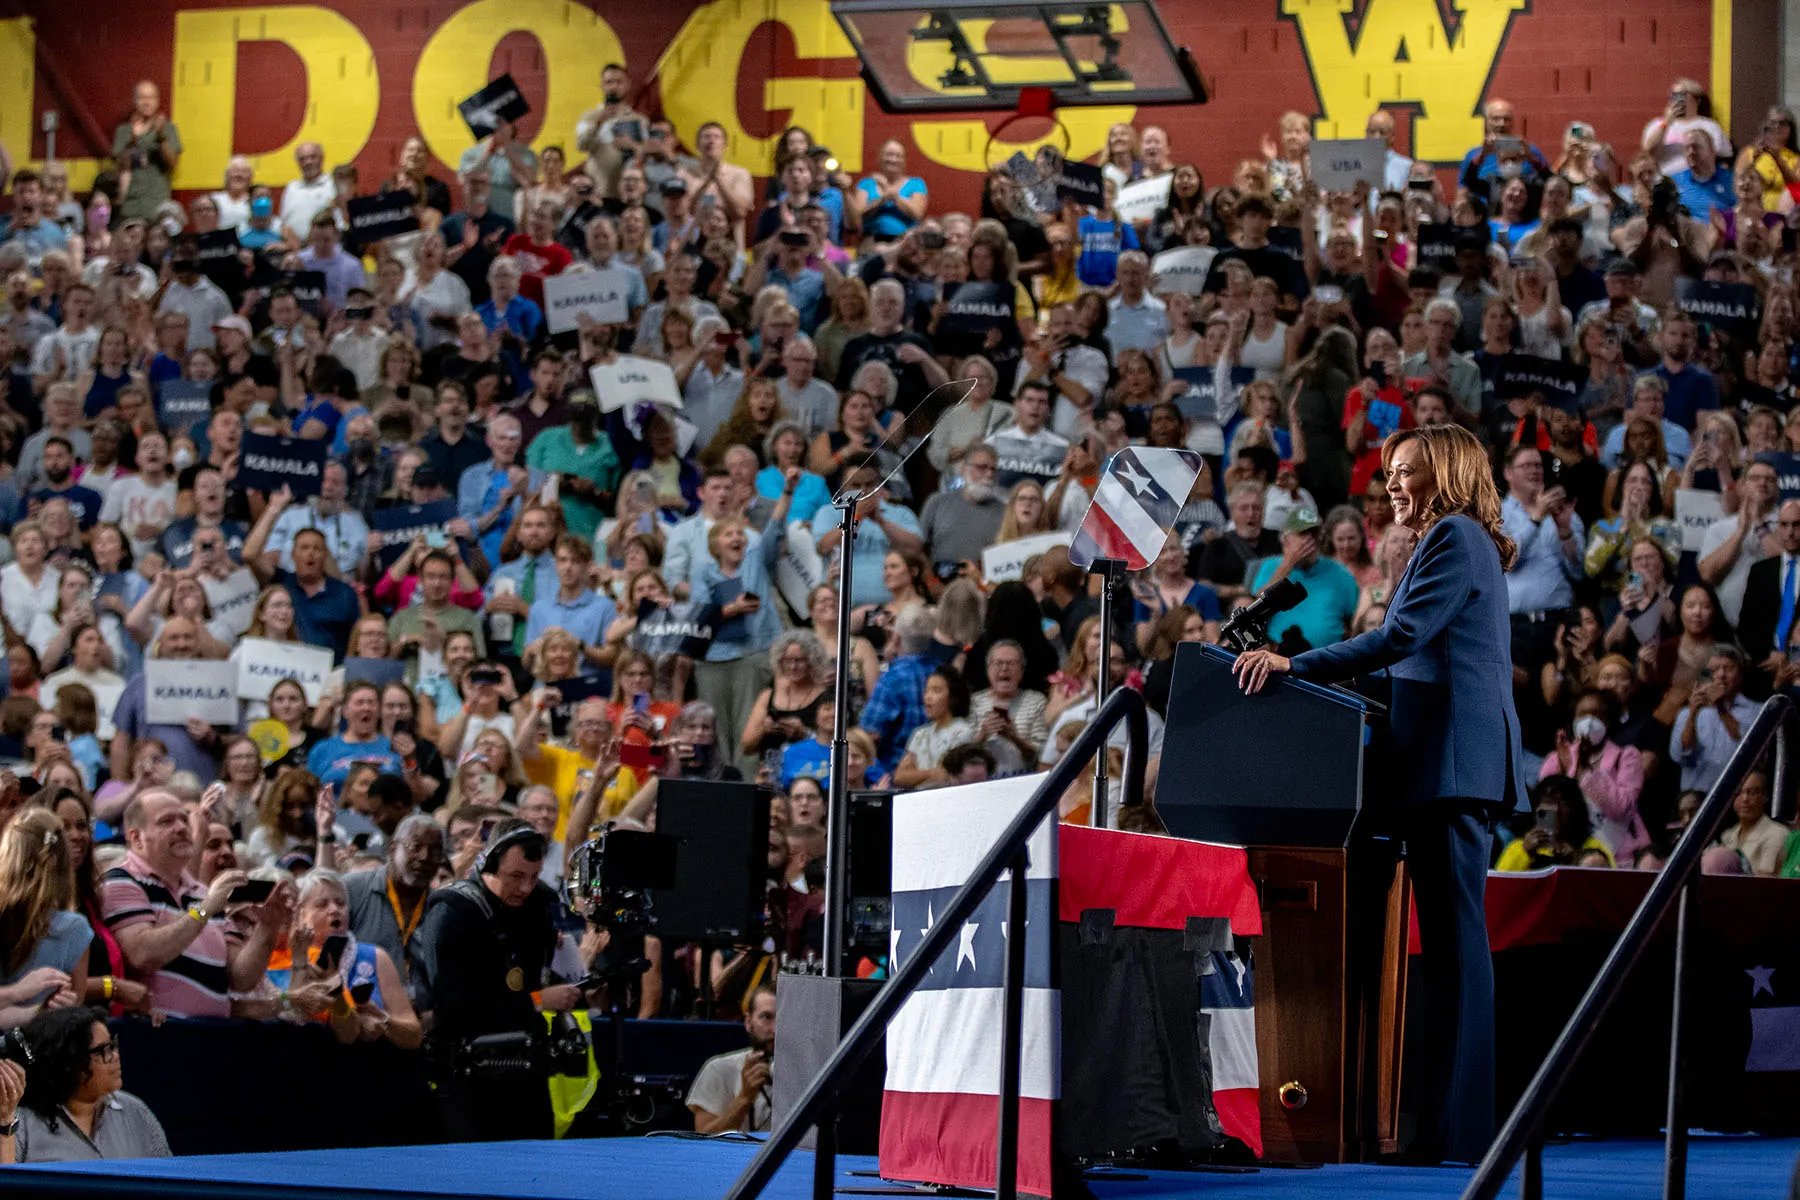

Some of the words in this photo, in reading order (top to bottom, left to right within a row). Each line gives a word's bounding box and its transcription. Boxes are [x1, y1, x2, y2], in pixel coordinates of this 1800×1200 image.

[1332, 161, 1362, 172] USA
[554, 292, 618, 309] KAMALA
[1679, 299, 1746, 318] KAMALA
[948, 303, 1012, 317] KAMALA
[618, 373, 649, 383] USA
[1504, 372, 1577, 394] KAMALA
[243, 453, 320, 477] KAMALA
[640, 621, 712, 640] KAMALA
[248, 664, 322, 684] KAMALA
[154, 686, 230, 700] KAMALA
